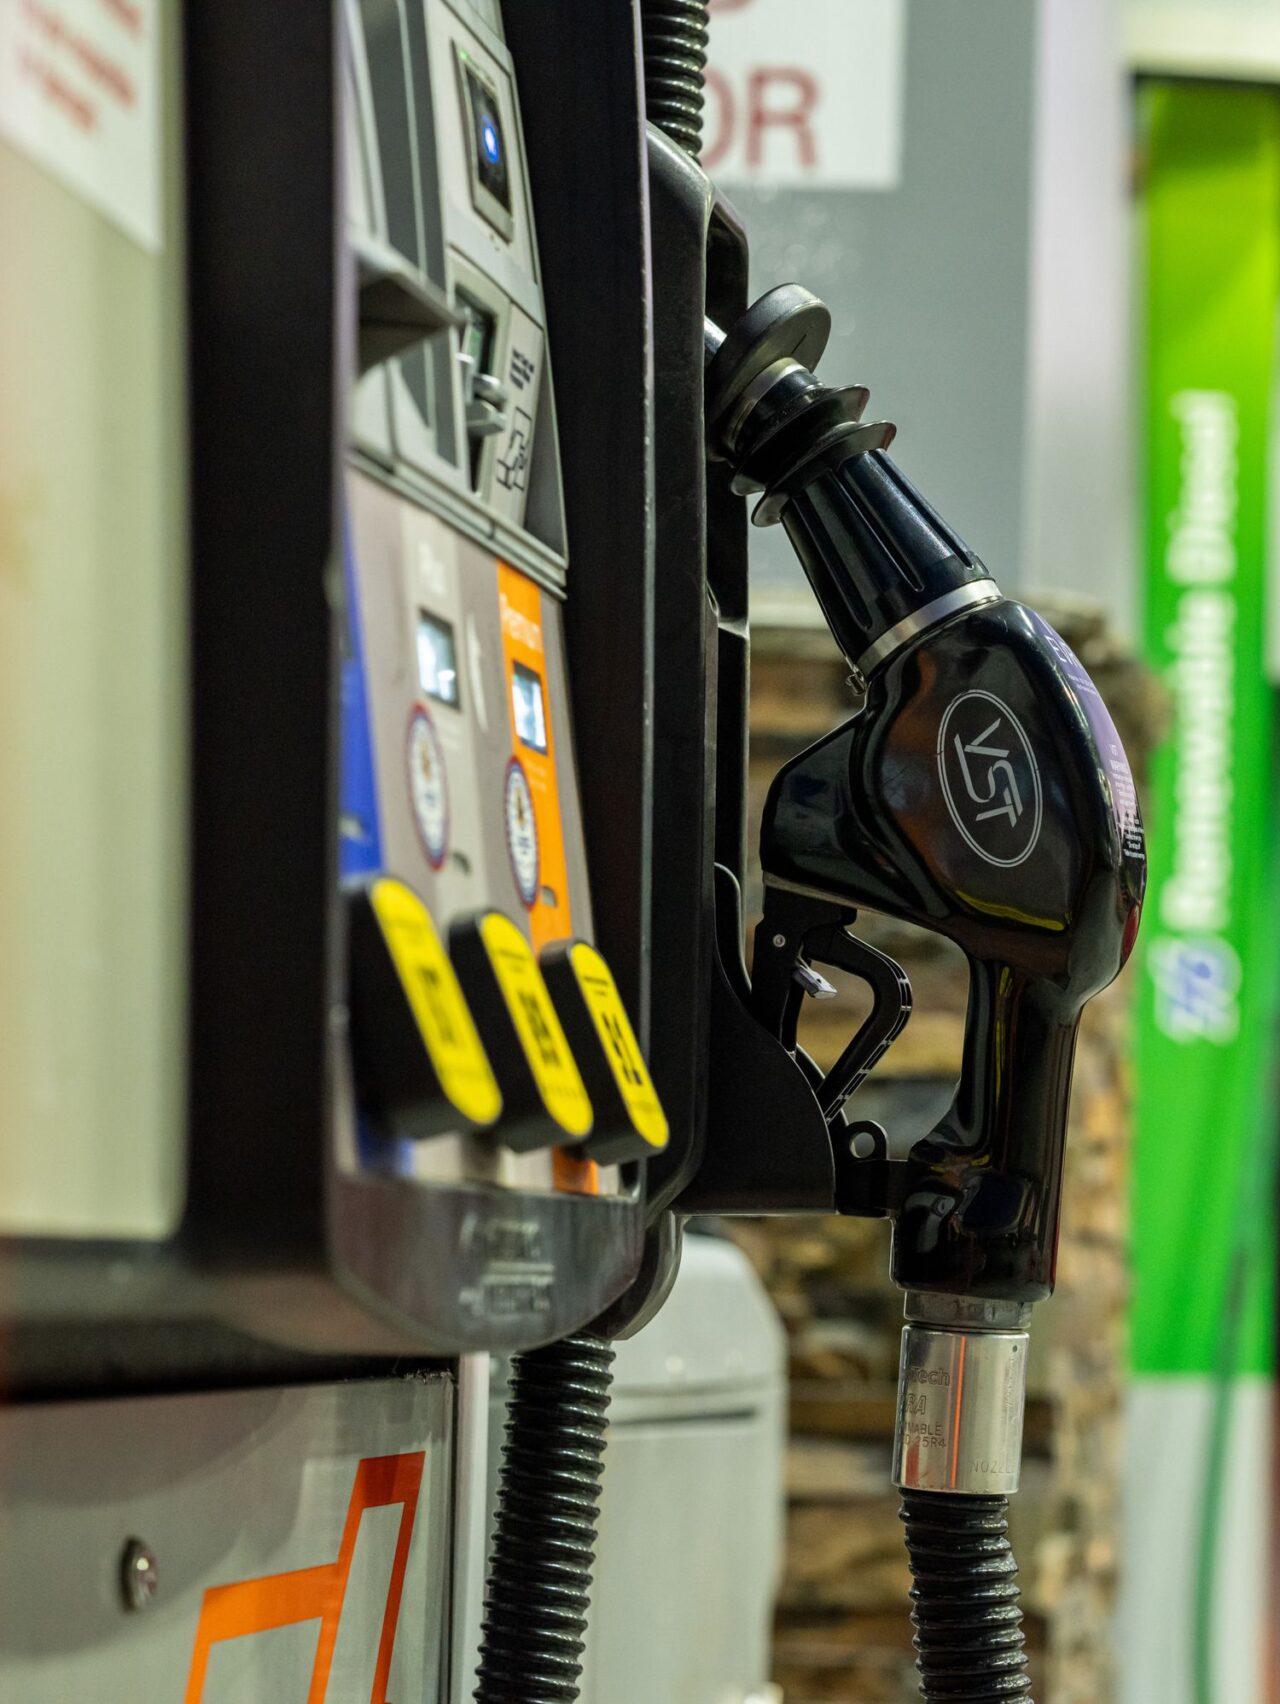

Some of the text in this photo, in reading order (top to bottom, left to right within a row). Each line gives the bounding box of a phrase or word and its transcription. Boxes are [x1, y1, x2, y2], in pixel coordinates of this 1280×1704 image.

[1167, 391, 1239, 583] Diesel
[954, 718, 1023, 828] VST
[1164, 589, 1238, 930] Renewable
